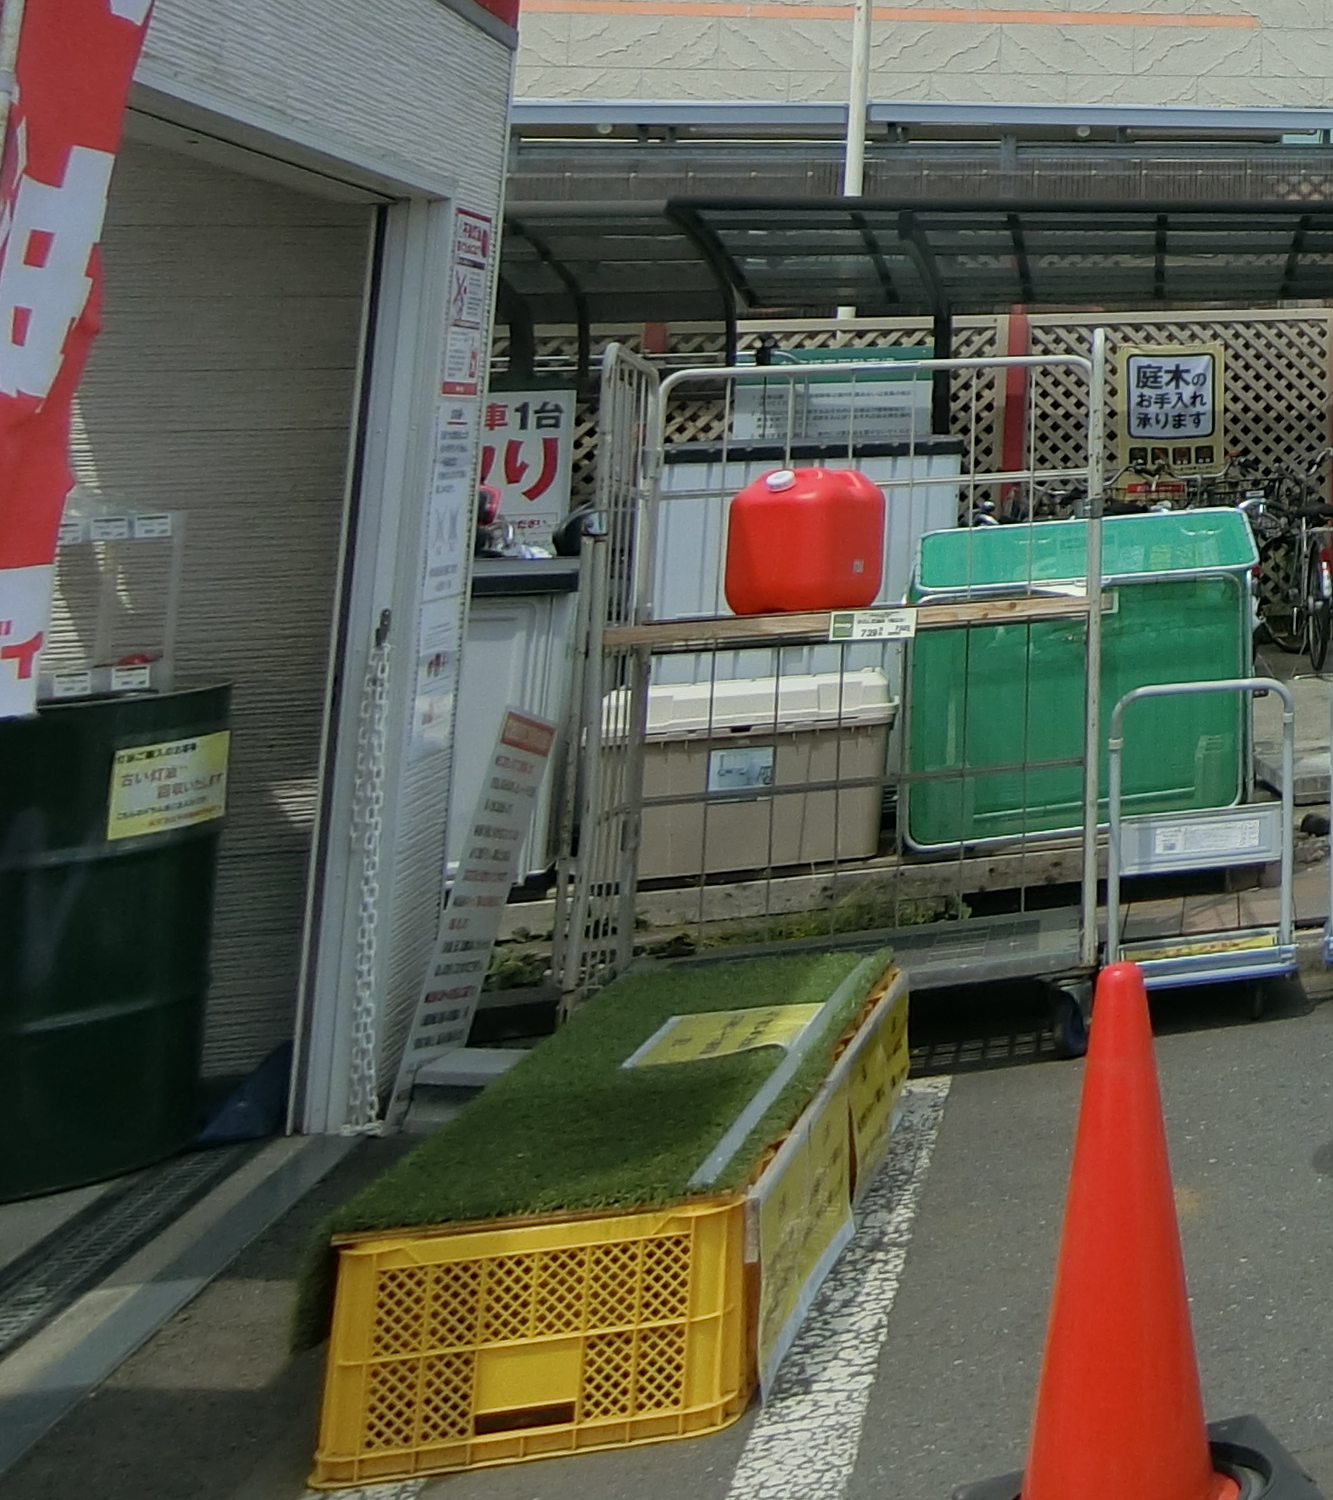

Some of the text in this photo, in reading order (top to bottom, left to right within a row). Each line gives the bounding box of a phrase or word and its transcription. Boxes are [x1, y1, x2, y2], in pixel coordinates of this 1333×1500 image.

[1135, 364, 1207, 390] 庭木の
[1136, 391, 1207, 408] お手入れ
[1136, 411, 1207, 430] 承ります
